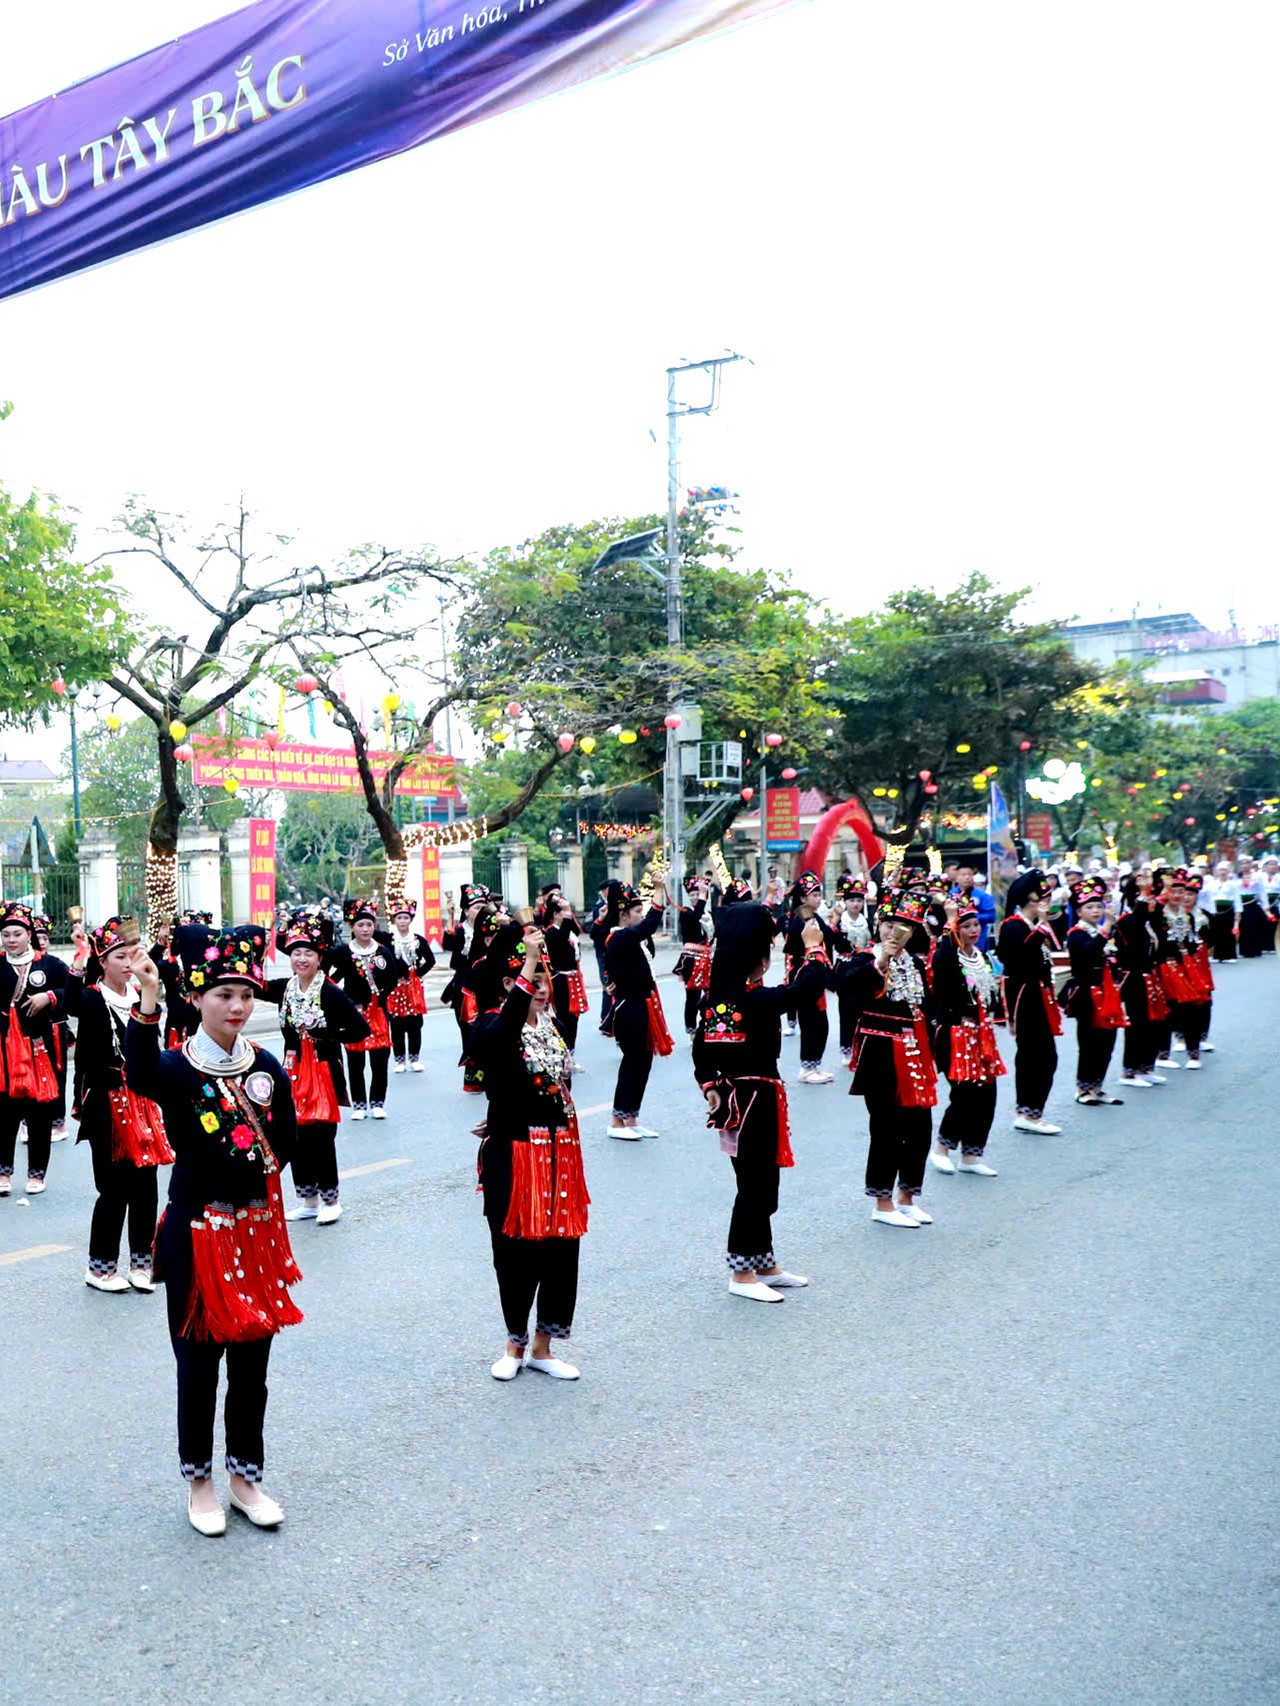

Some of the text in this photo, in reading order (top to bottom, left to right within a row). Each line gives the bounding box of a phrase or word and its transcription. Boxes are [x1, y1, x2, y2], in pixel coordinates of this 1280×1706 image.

[382, 38, 409, 67] Sở
[415, 25, 455, 53] Văn
[461, 6, 508, 36] hóa,
[80, 116, 177, 188] TÂY
[192, 54, 307, 147] BẮC
